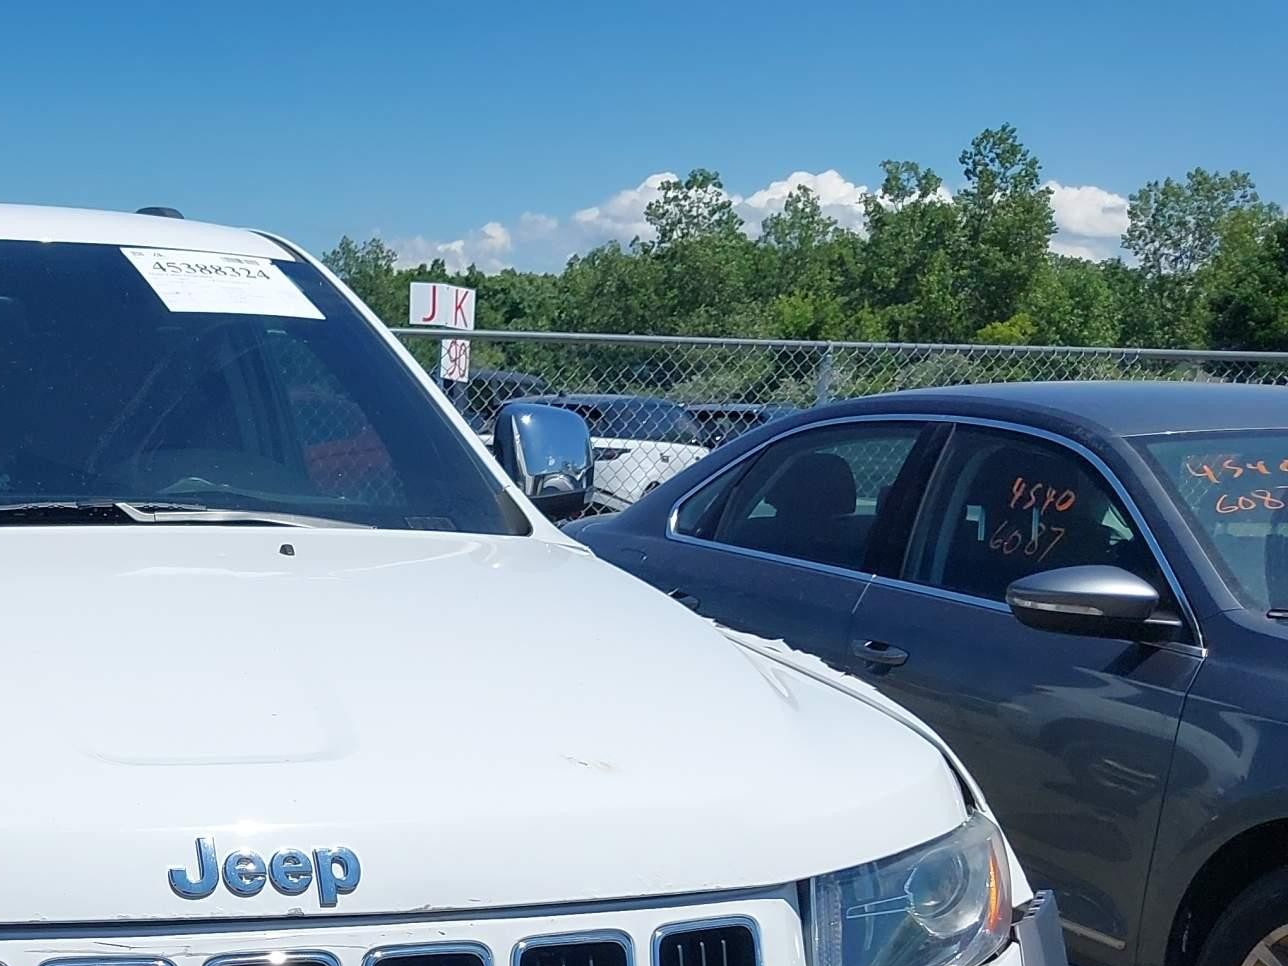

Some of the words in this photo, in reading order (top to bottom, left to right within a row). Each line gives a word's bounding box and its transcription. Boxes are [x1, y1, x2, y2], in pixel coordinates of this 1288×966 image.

[152, 260, 271, 281] 45388324
[422, 284, 437, 322] J
[454, 288, 470, 328] K
[1010, 477, 1076, 516] 4540
[989, 519, 1066, 563] 6087
[167, 836, 362, 908] Jeep
